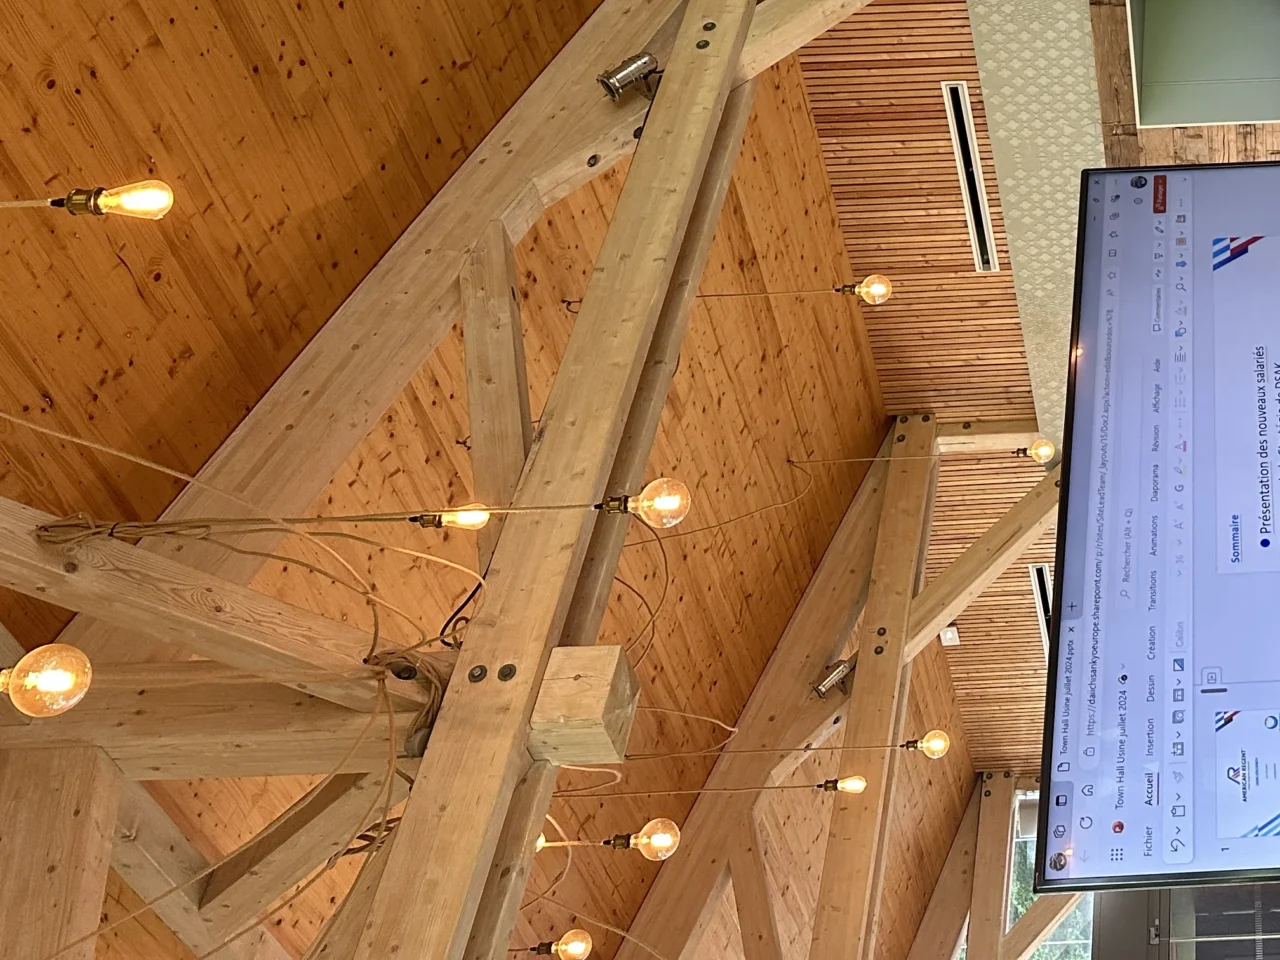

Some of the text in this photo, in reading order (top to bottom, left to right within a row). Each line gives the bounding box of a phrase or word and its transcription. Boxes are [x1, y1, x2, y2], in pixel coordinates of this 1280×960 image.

[1252, 346, 1272, 534] Présentation des nouveaux salariés
[1123, 528, 1132, 539] (Alt
[1124, 508, 1133, 517] Q)
[1230, 514, 1240, 563] Sommaire
[1122, 542, 1132, 582] Rechercher
[1143, 358, 1162, 857] Fichier Accueil Insertion Dessin Création Transitions Animations Diaporama Révision Affichage Aide
[1060, 640, 1075, 755] Town Hall Usine juillet 2024.pptx
[1115, 690, 1128, 809] Town Hall Usine juillet 2024
